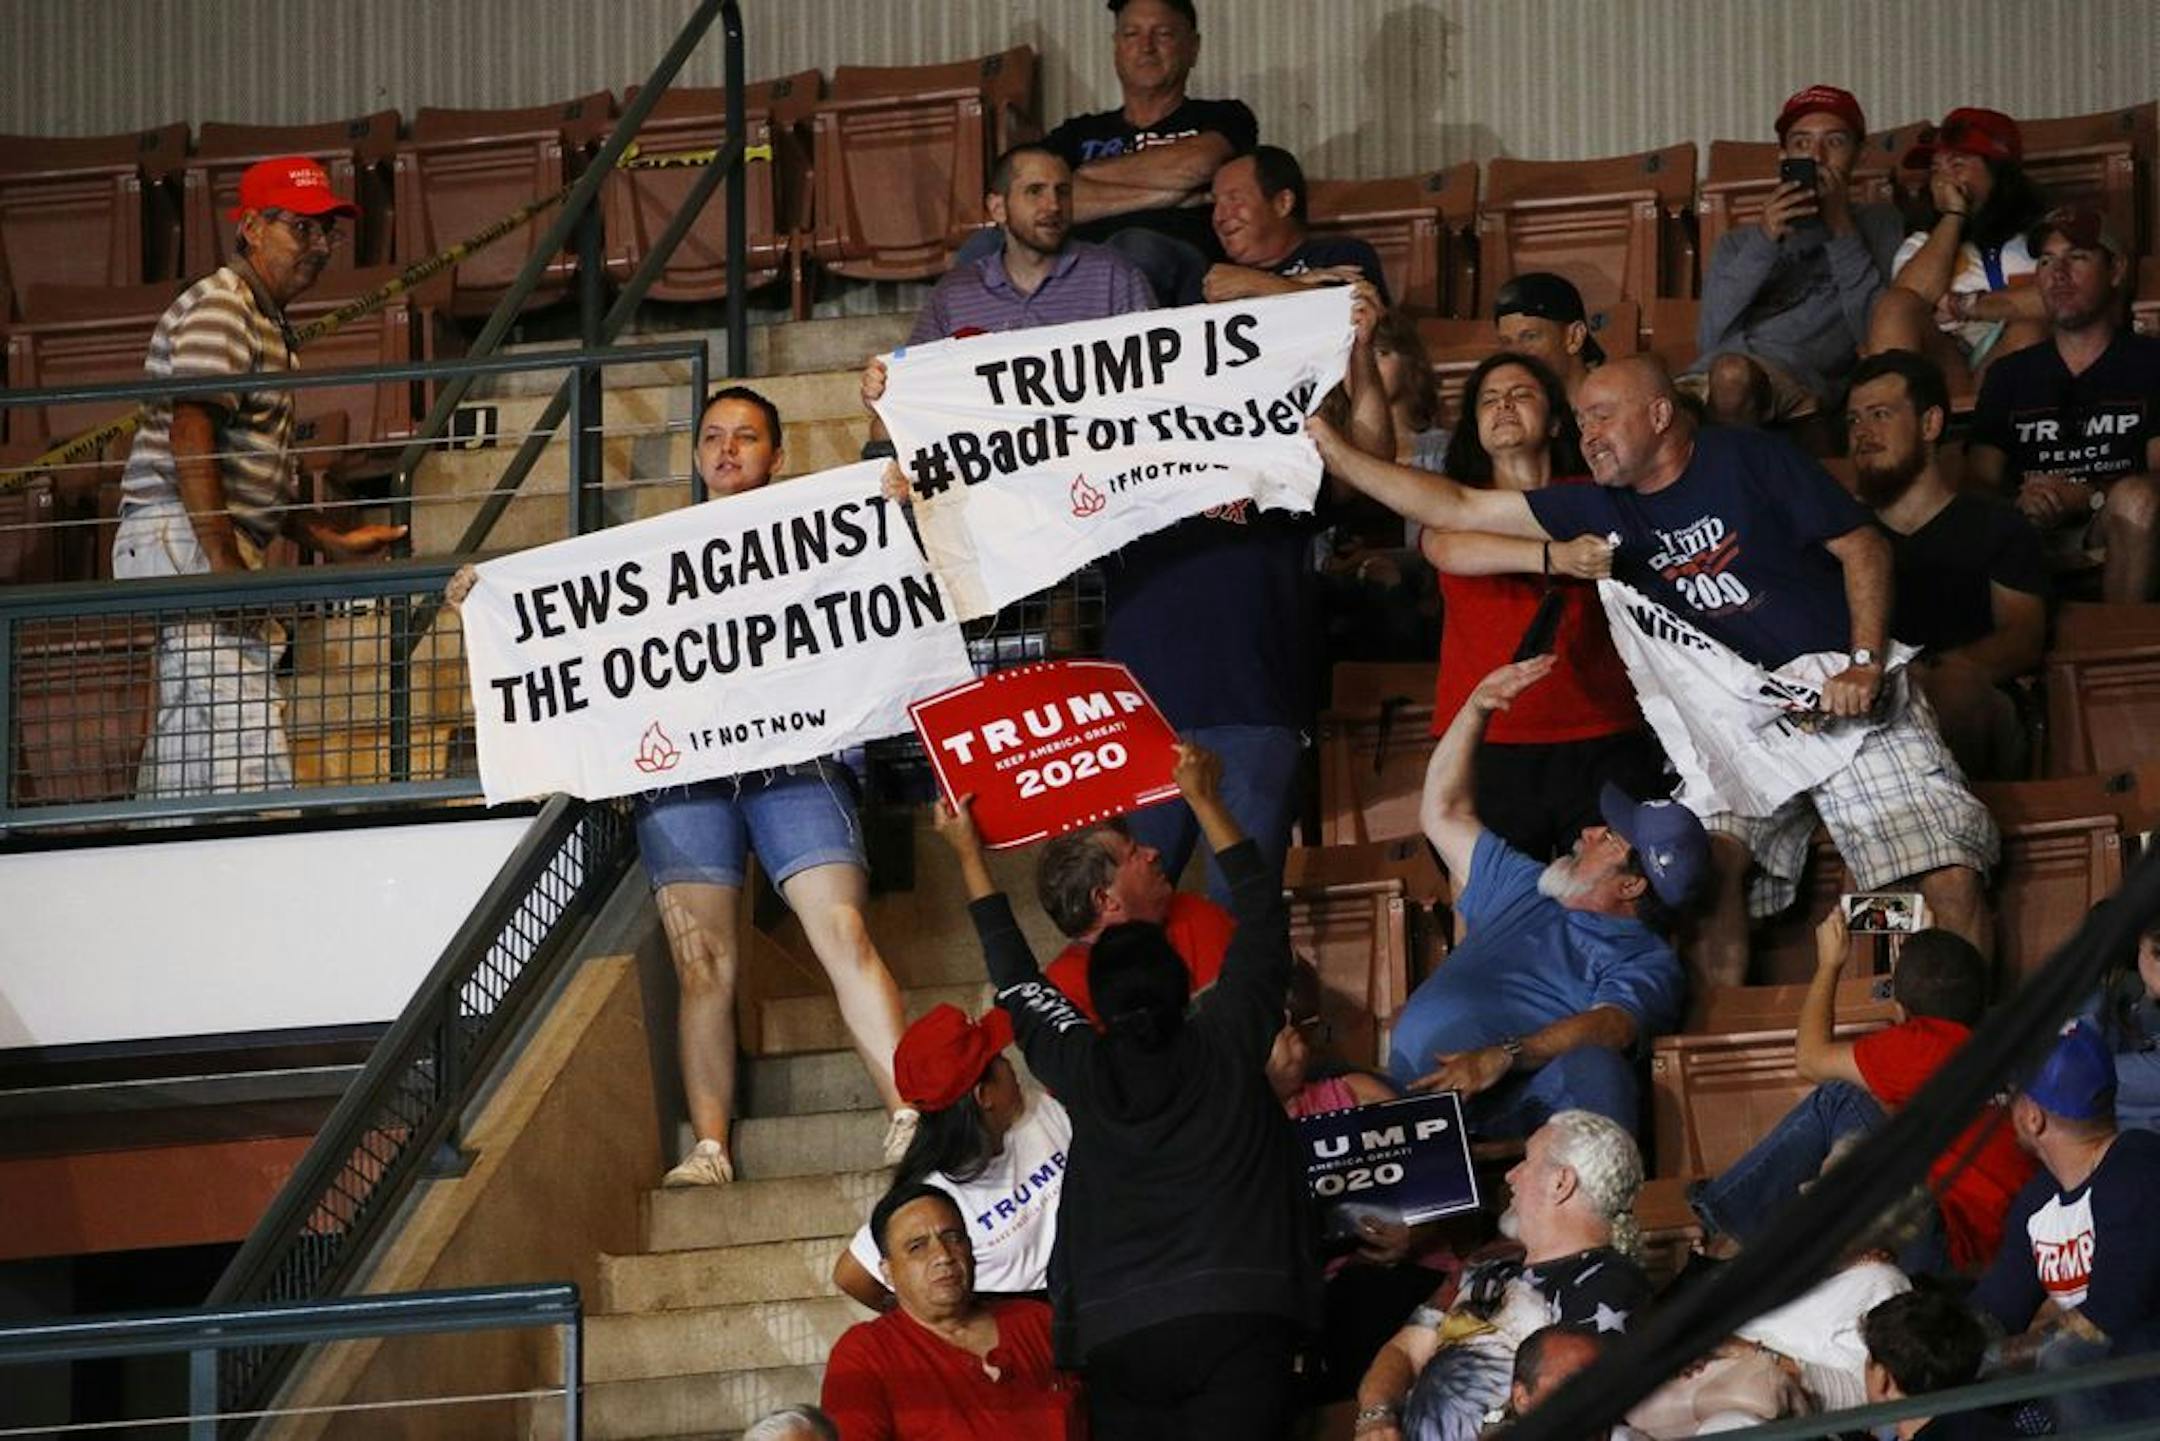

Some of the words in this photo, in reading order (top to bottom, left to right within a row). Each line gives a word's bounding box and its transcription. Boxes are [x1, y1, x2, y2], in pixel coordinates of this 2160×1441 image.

[975, 327, 1181, 406] TRUMP
[1204, 313, 1261, 376] IS
[2015, 414, 2141, 443] TRMP
[2038, 442, 2112, 463] PENCE
[512, 561, 649, 643] JEWS
[667, 495, 889, 605] AGAINST
[491, 656, 589, 723] THE
[603, 572, 947, 698] OCCUPATION
[941, 690, 1145, 765] TRUMP
[995, 753, 1026, 771] KEEP
[1029, 734, 1083, 760] AMERICA
[1083, 721, 1128, 741] GREAT!
[1015, 742, 1128, 799] 2020
[977, 1151, 1067, 1231] TRUMP
[1307, 1156, 1364, 1173] AMERICA
[1308, 1162, 1404, 1199] 020
